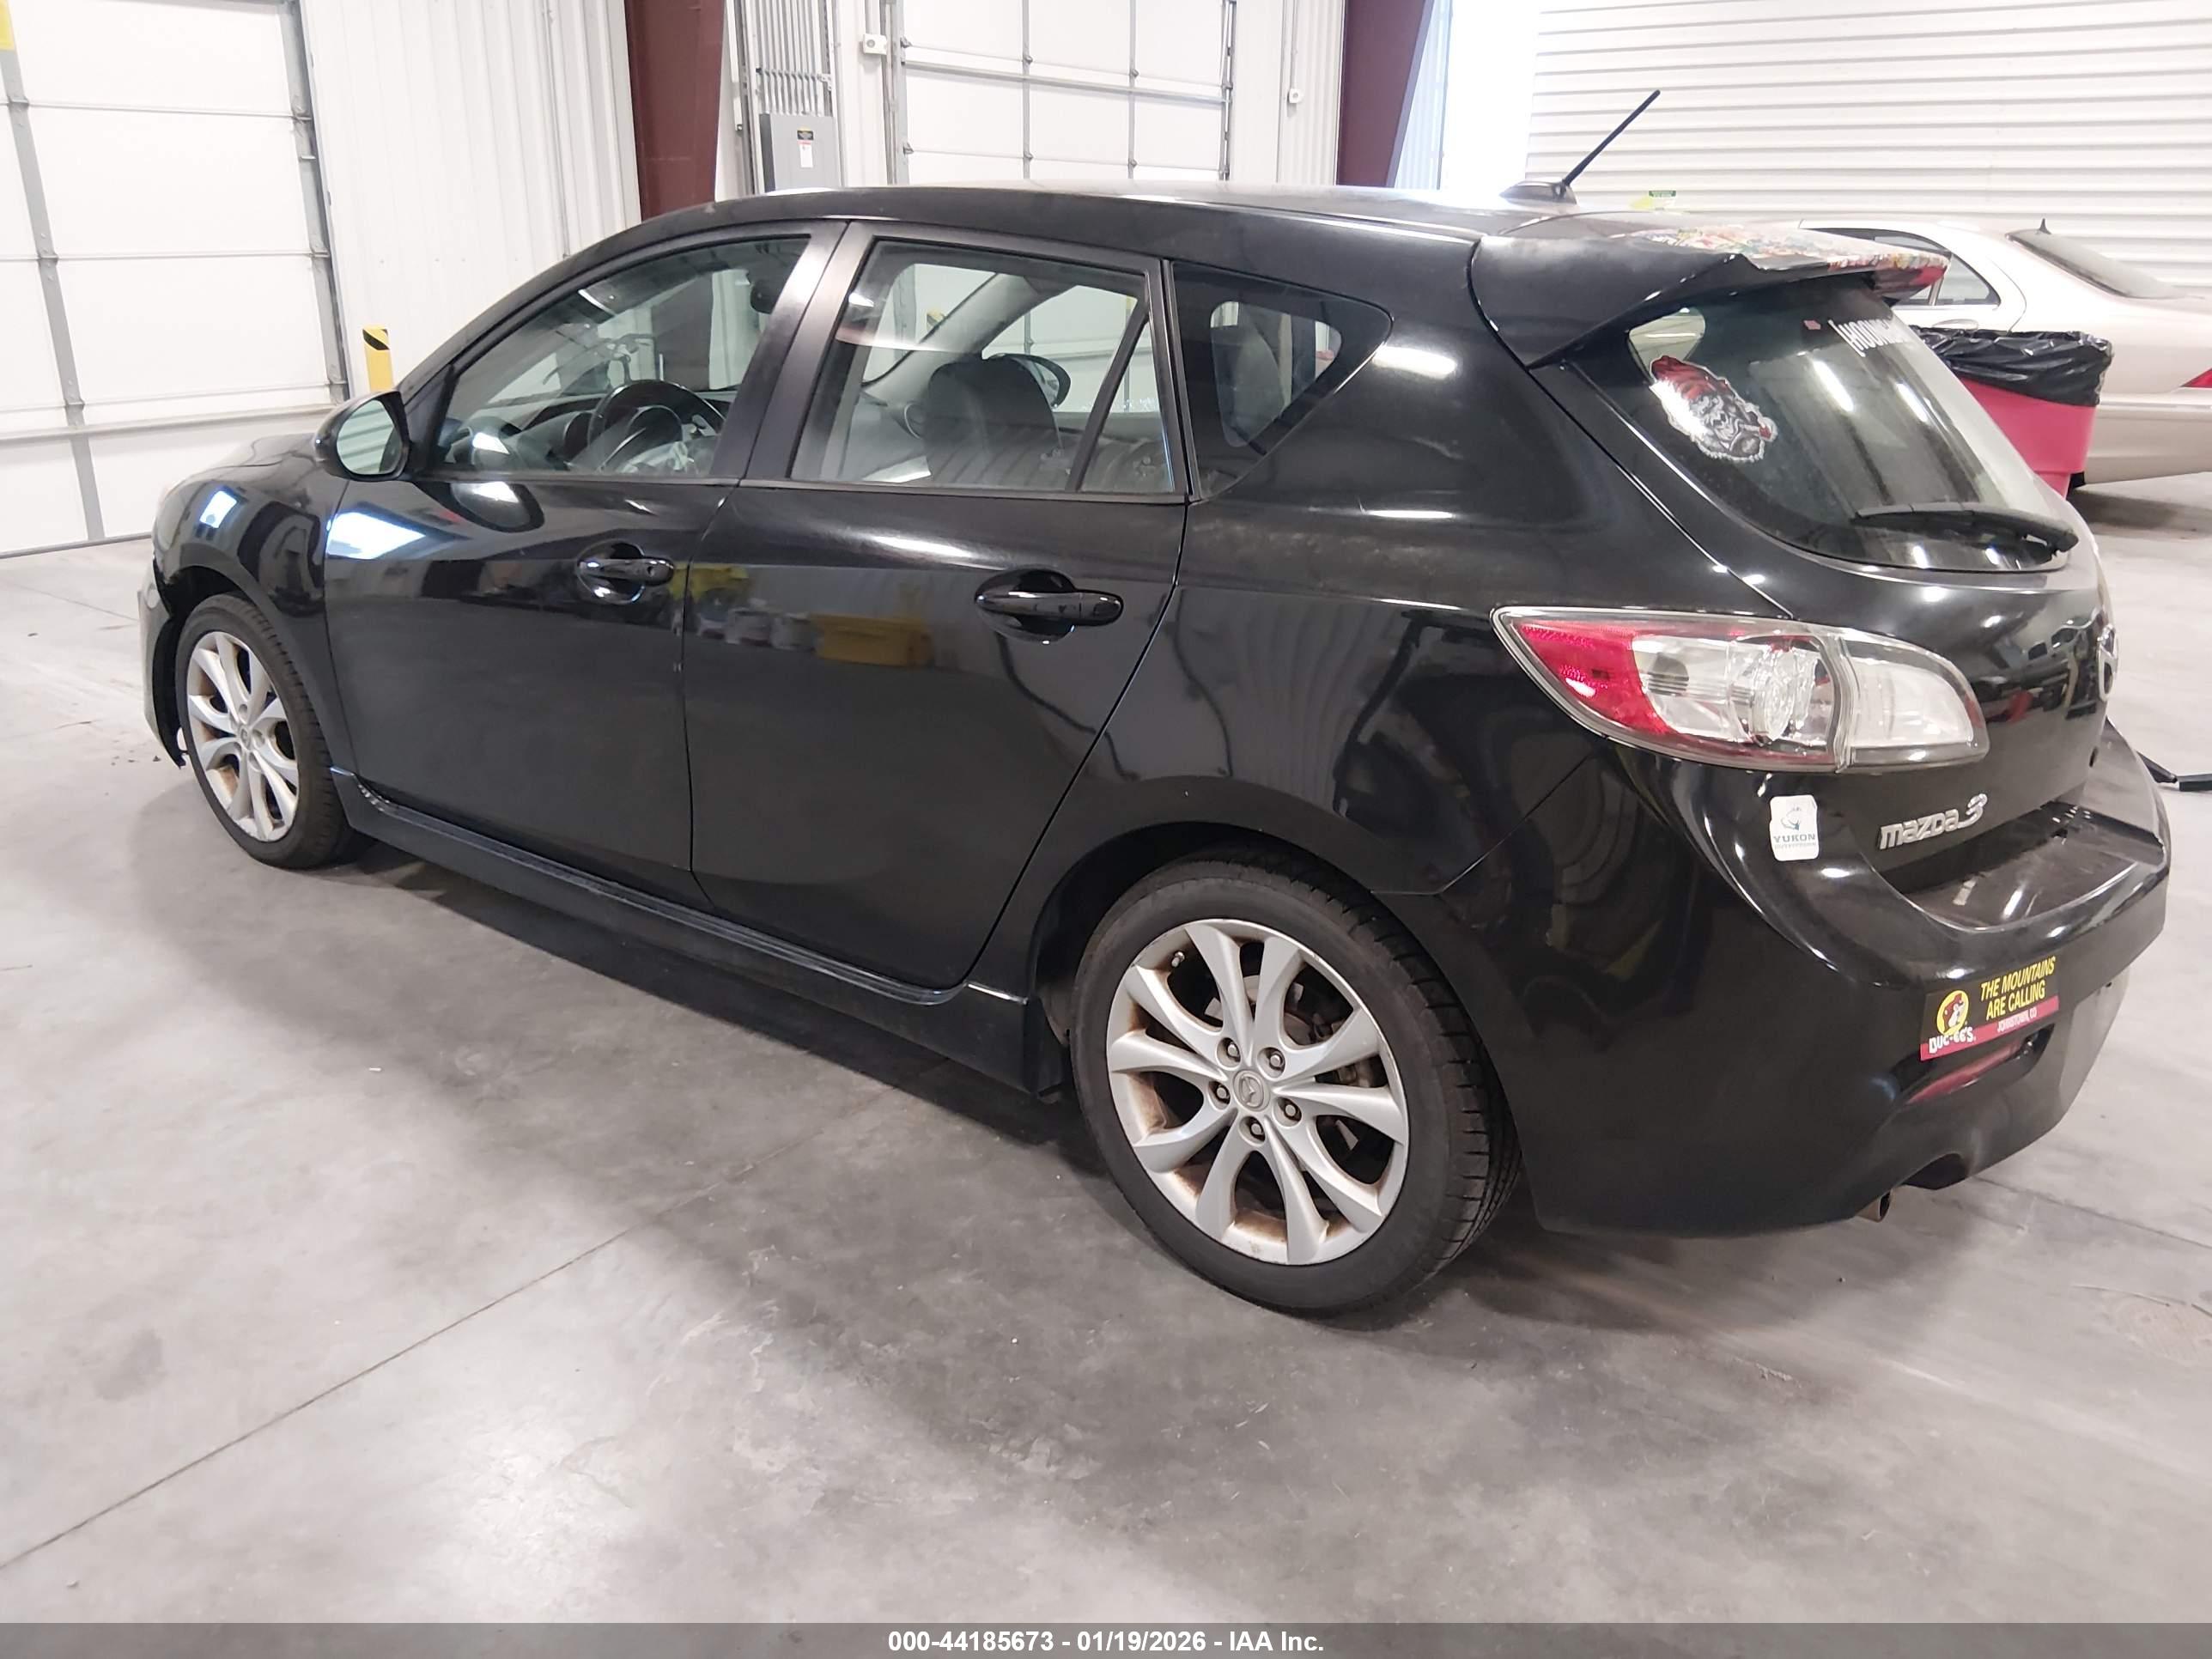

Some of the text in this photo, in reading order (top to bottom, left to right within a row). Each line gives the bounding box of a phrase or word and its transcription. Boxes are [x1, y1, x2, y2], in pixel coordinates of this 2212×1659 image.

[1773, 833, 1815, 843] YUKON
[1980, 955, 2056, 1002] THE MOUNTAINS
[1985, 979, 2046, 1021] ARE CALLING
